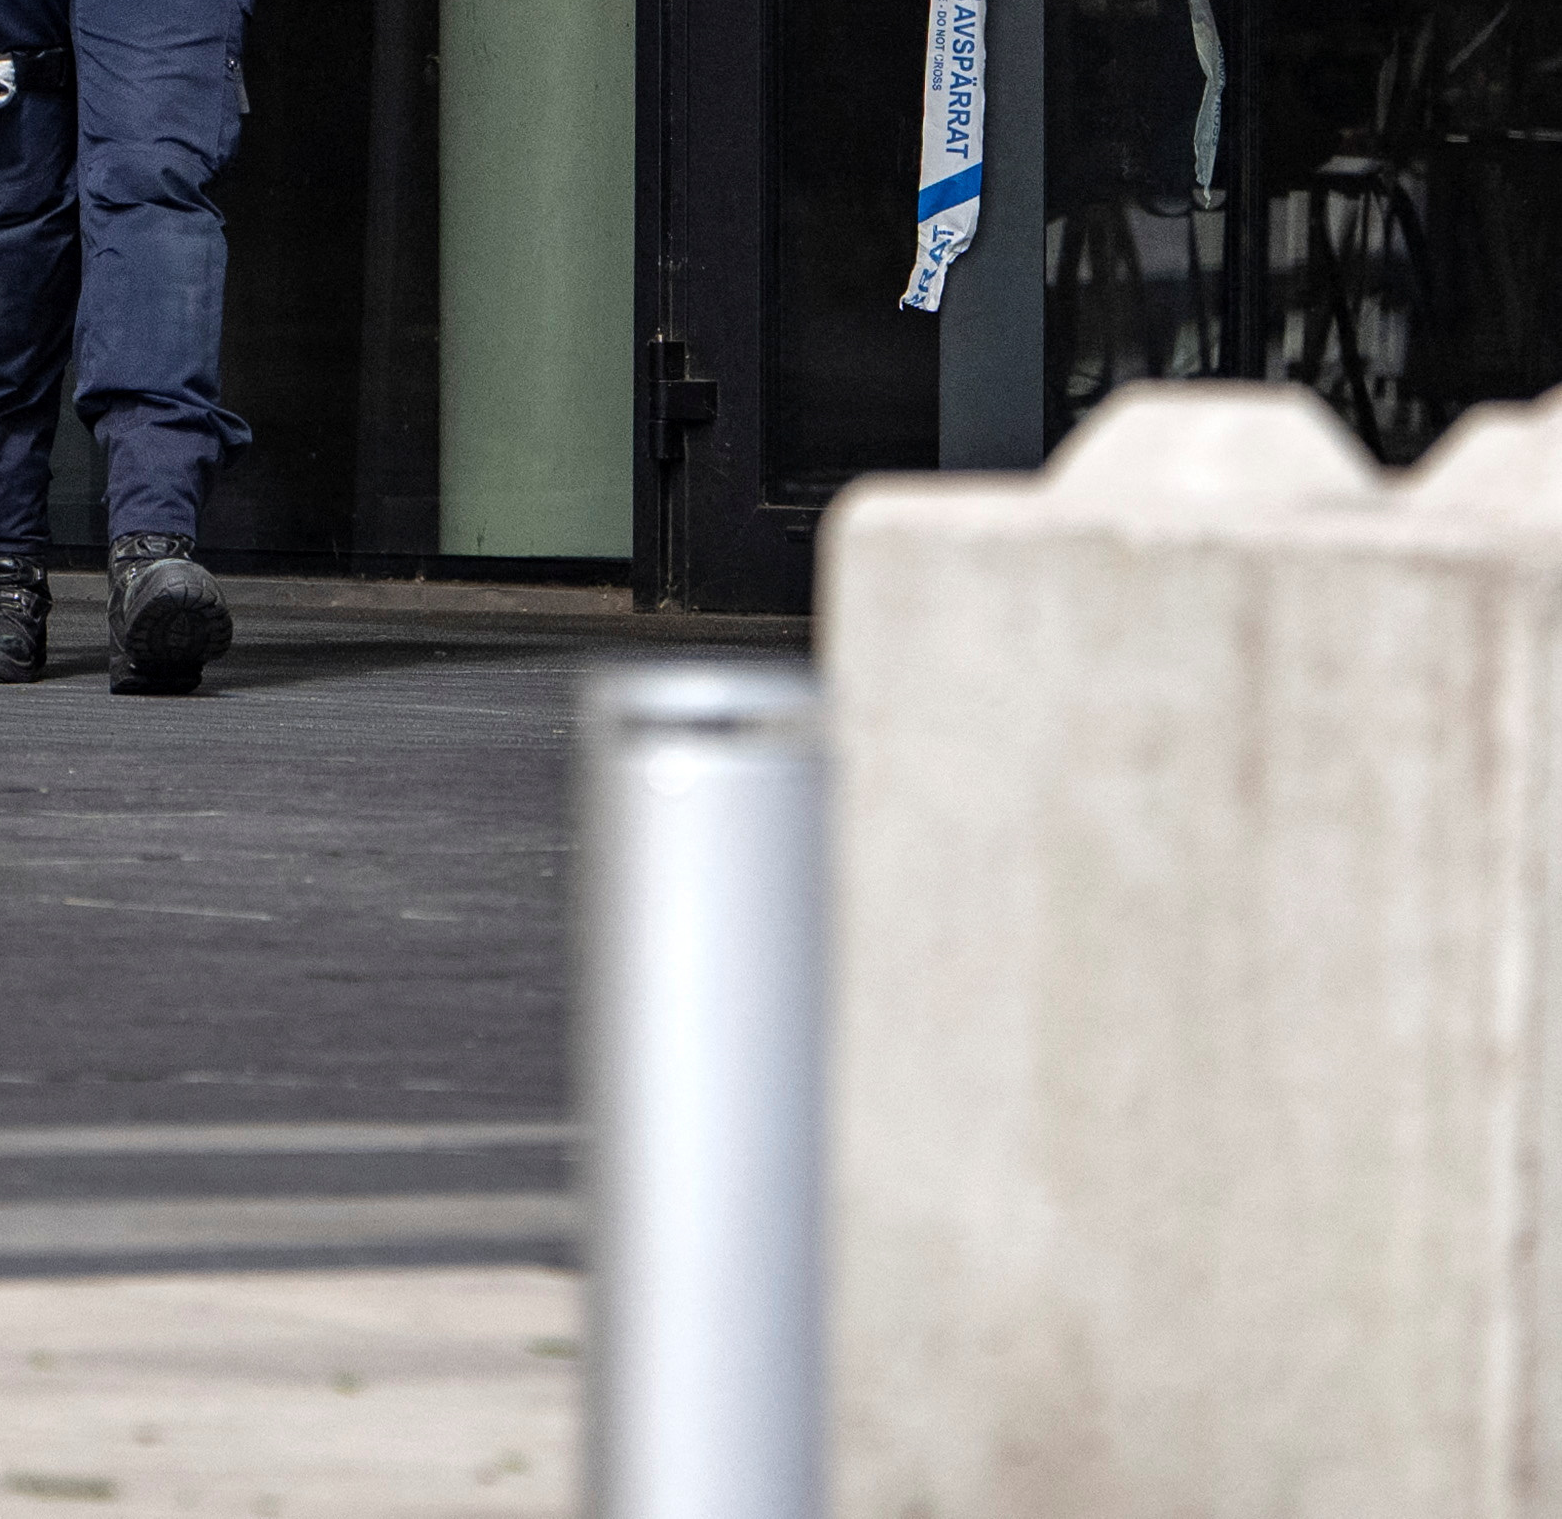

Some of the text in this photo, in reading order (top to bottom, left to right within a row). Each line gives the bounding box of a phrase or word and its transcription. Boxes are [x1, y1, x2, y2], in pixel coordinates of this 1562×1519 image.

[936, 10, 947, 27] DO
[935, 29, 946, 50] NOT
[932, 54, 944, 91] CROSS
[944, 4, 978, 160] AVSPÄRRAT
